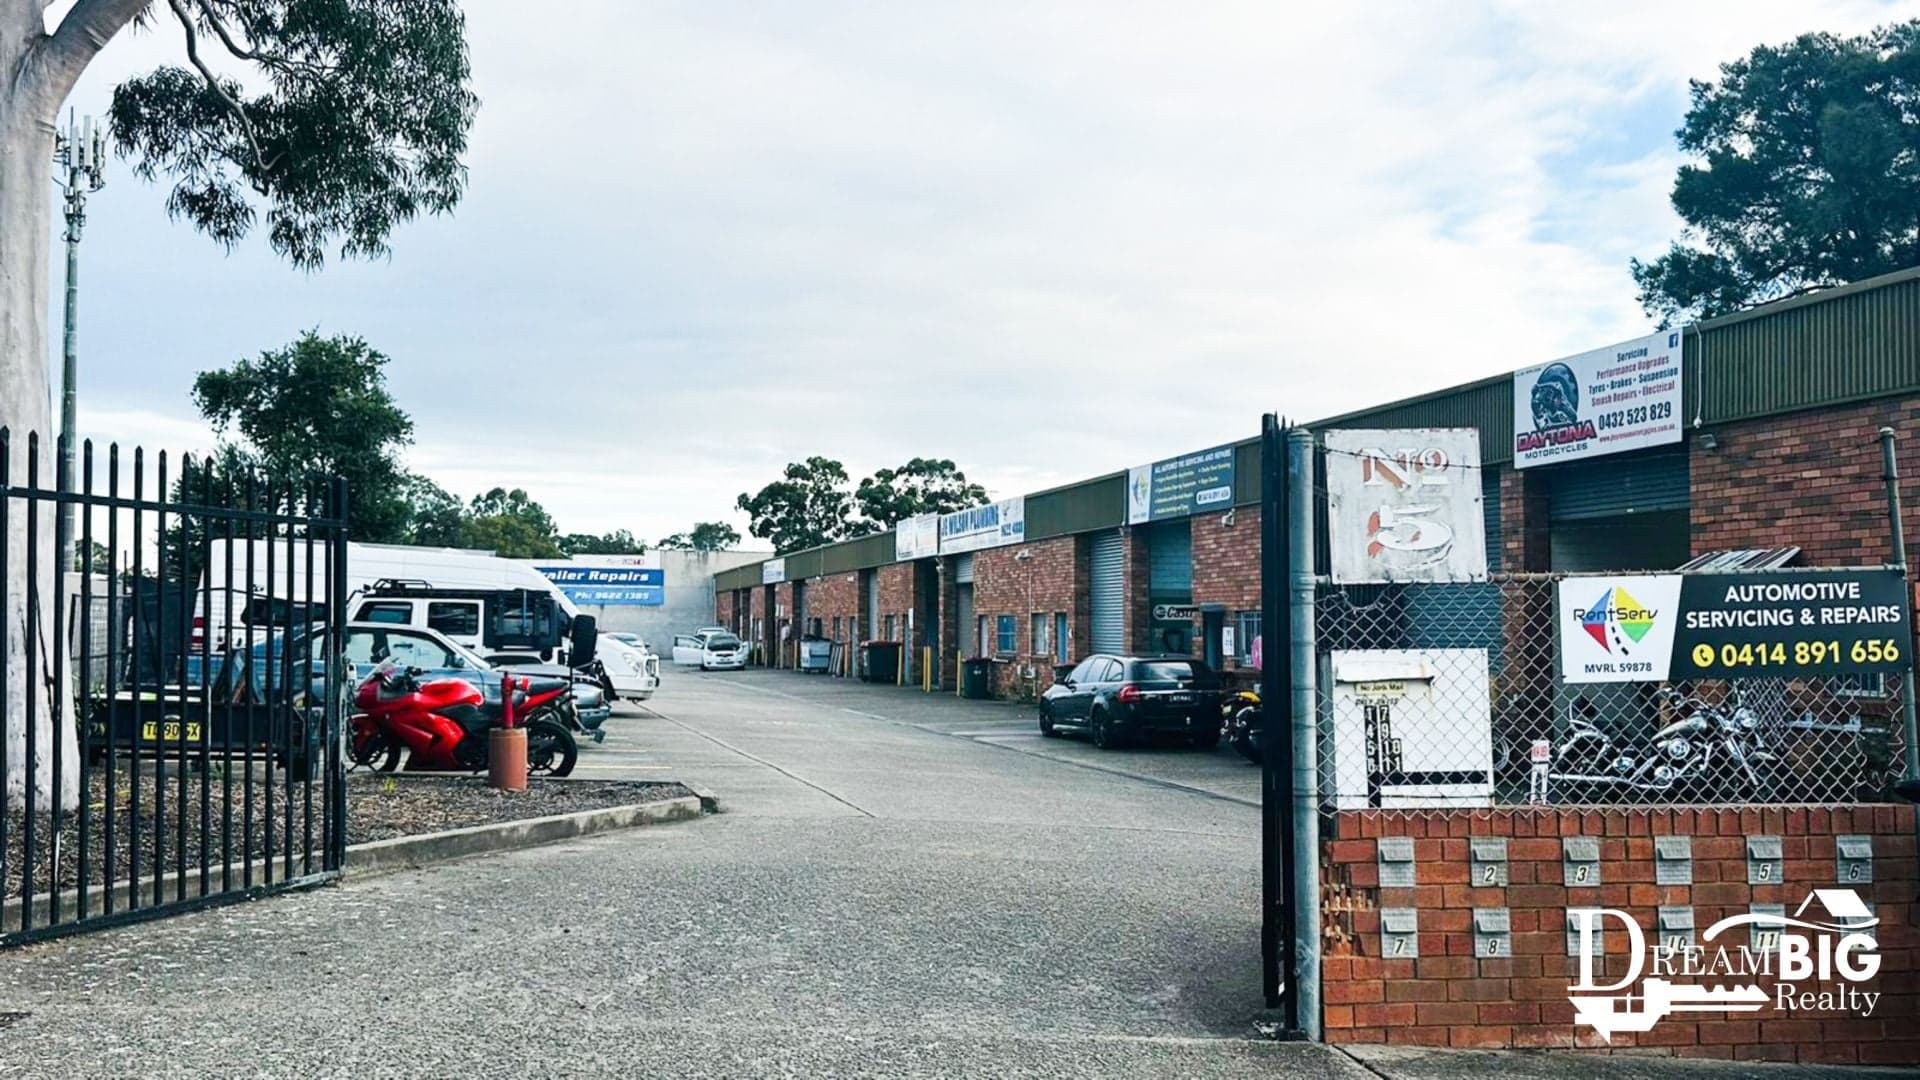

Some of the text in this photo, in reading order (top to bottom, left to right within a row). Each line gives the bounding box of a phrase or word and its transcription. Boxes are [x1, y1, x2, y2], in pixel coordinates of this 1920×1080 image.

[1617, 347, 1648, 362] Servicing
[1597, 355, 1669, 379] Performance Upgrades
[1589, 367, 1678, 395] Tyres Brakes Suspension
[1591, 380, 1675, 407] Smash Repairs Electrical
[1599, 401, 1671, 431] 0432 523 829
[1517, 420, 1597, 452] DAYTONA
[1525, 443, 1588, 460] MOTORCYCLES
[1367, 503, 1454, 561] 5
[543, 570, 649, 582] railer Repairs
[1724, 582, 1861, 602] AUTOMOTIVE
[1573, 607, 1658, 623] RentServ
[1686, 606, 1900, 628] SERVICING & REPAIRS
[1721, 639, 1899, 668] 0414 891 656
[1584, 662, 1653, 674] MVRL 59878
[1380, 707, 1388, 720] 7
[1366, 723, 1389, 738] 4 9
[1367, 740, 1401, 755] 5 10
[1485, 867, 1496, 882] 2
[1576, 866, 1589, 882] 3
[1759, 864, 1770, 879] 5
[1850, 864, 1860, 880] 6
[1395, 939, 1405, 954] 7
[1488, 939, 1498, 955] 8
